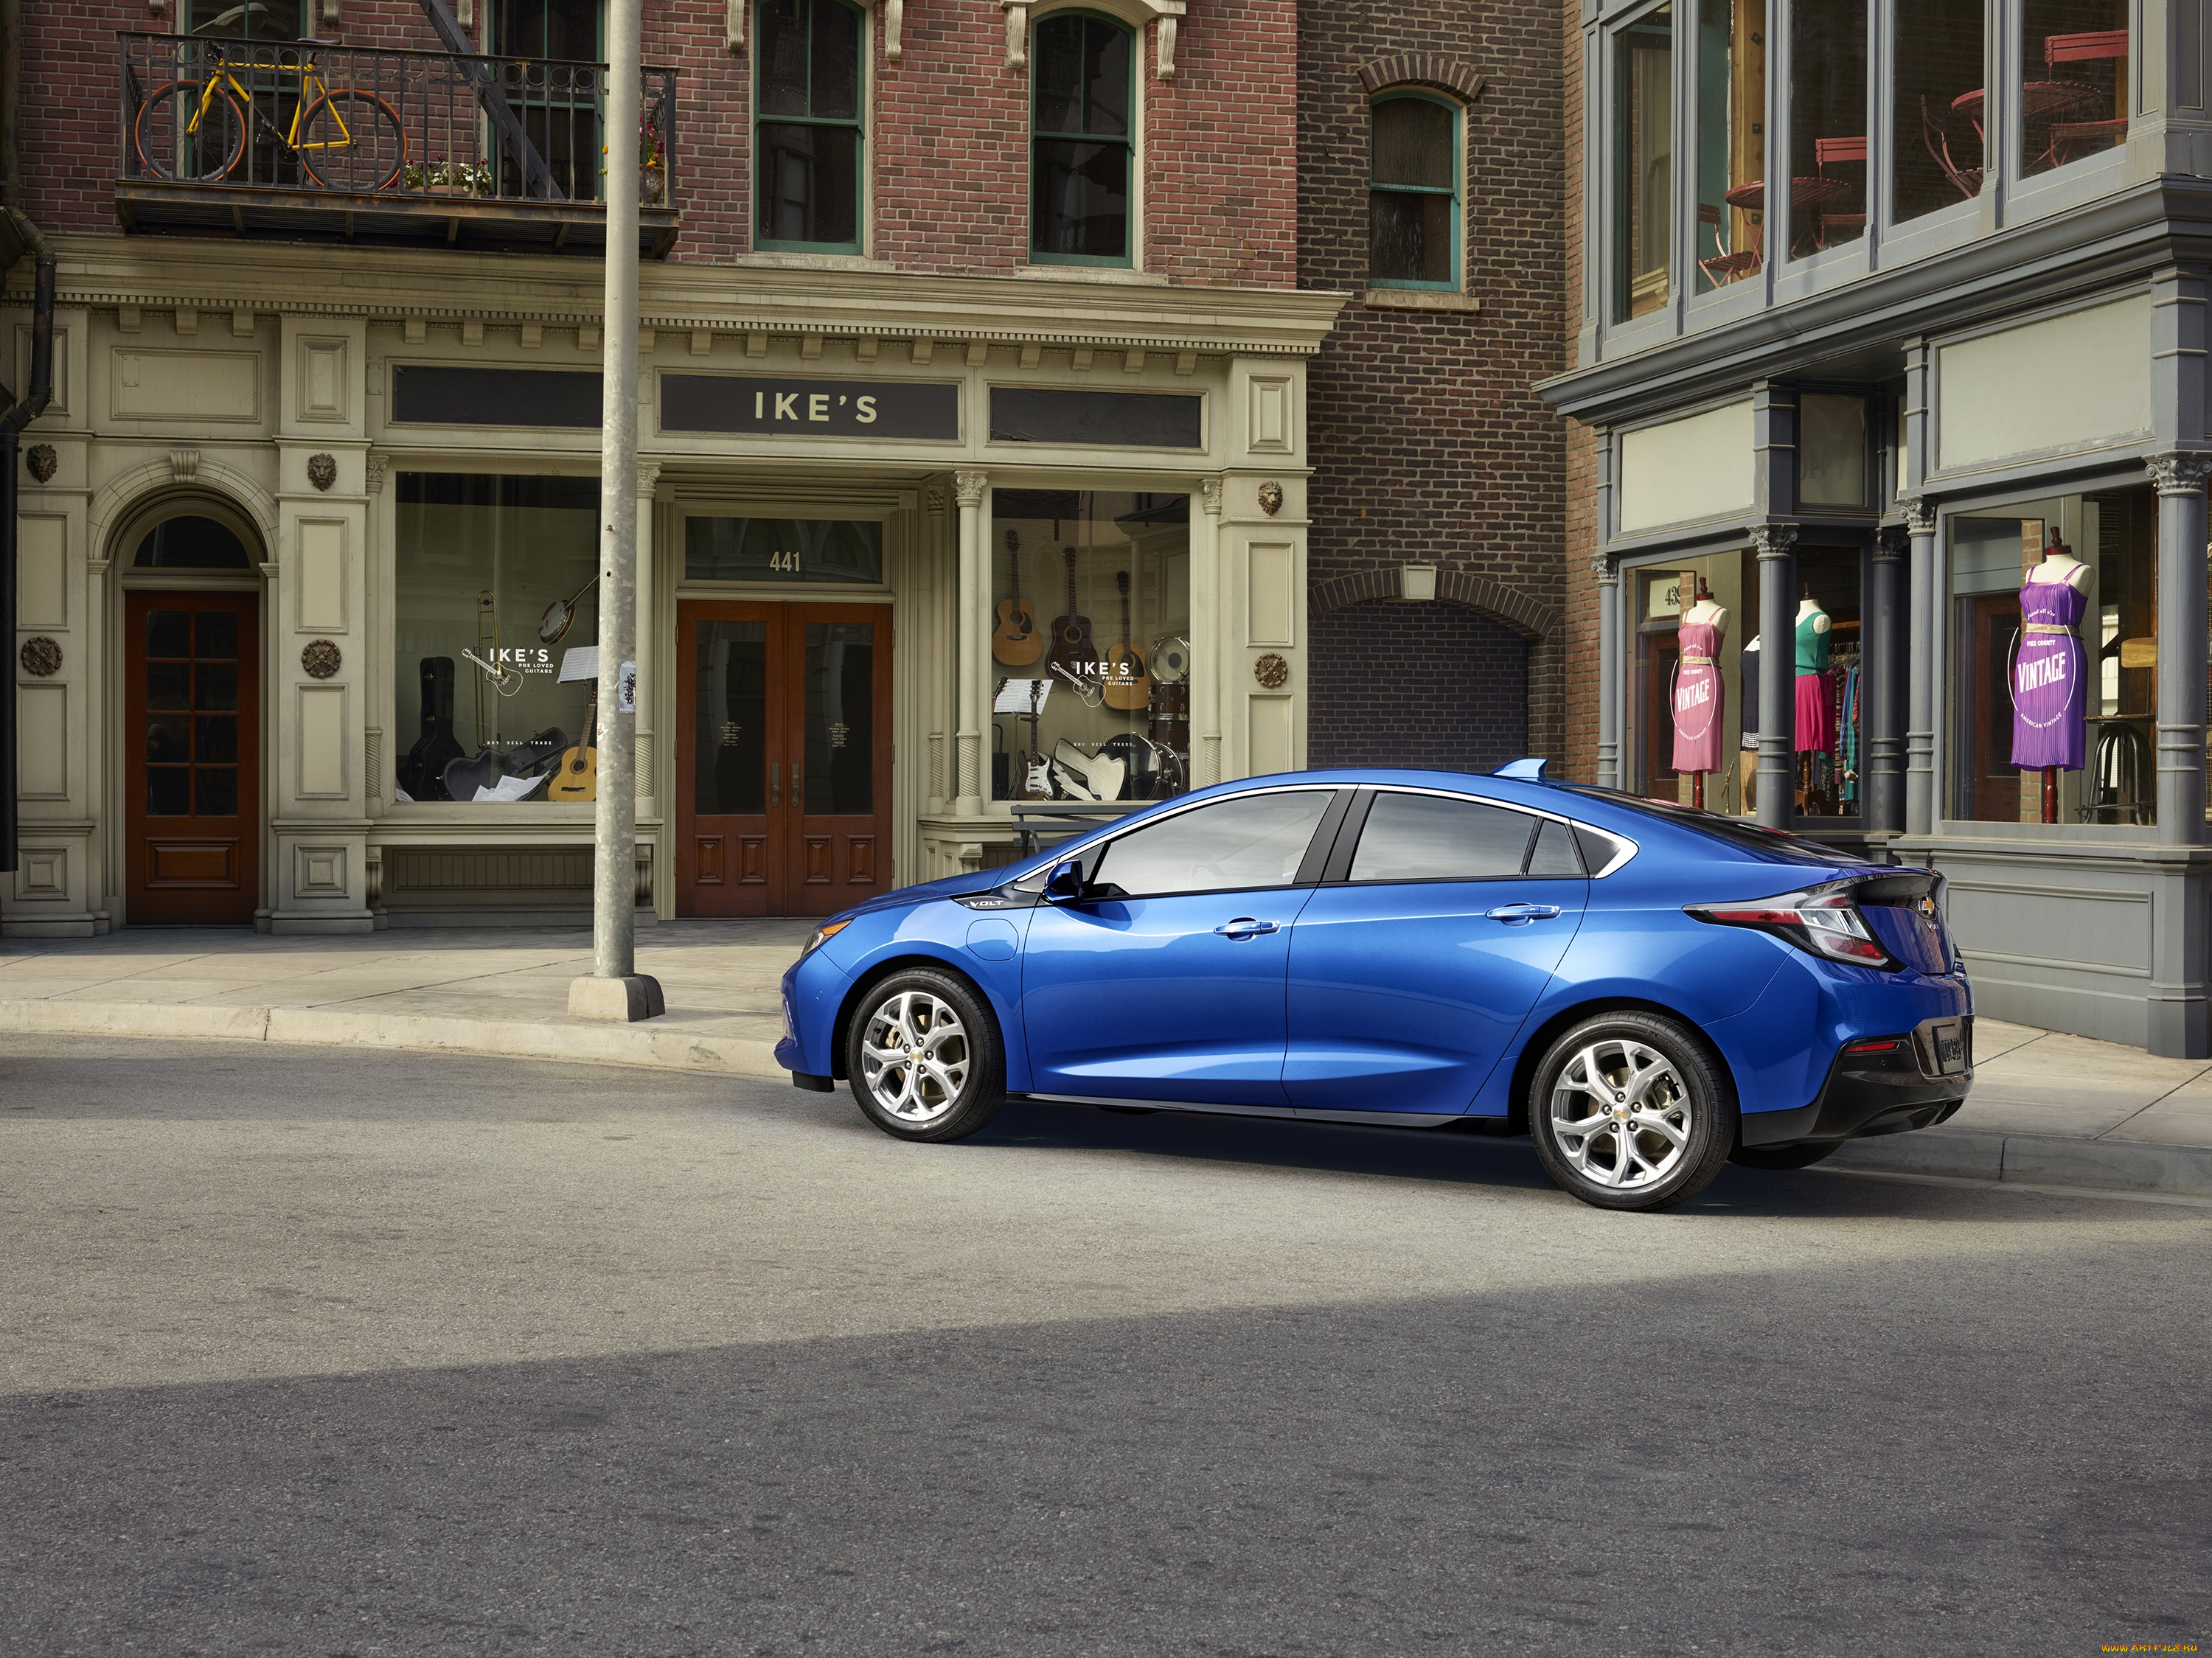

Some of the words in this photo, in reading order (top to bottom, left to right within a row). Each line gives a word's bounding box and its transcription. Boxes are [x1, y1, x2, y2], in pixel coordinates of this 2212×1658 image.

[755, 391, 877, 423] IKE'S
[769, 551, 799, 572] 441
[490, 648, 549, 663] IKE'S
[1076, 662, 1130, 675] IKE'S
[2017, 651, 2065, 693] VINTAGE
[1677, 678, 1709, 713] VINTAGE
[2020, 713, 2042, 728] AMERICAN
[2043, 711, 2062, 728] VINTAGE
